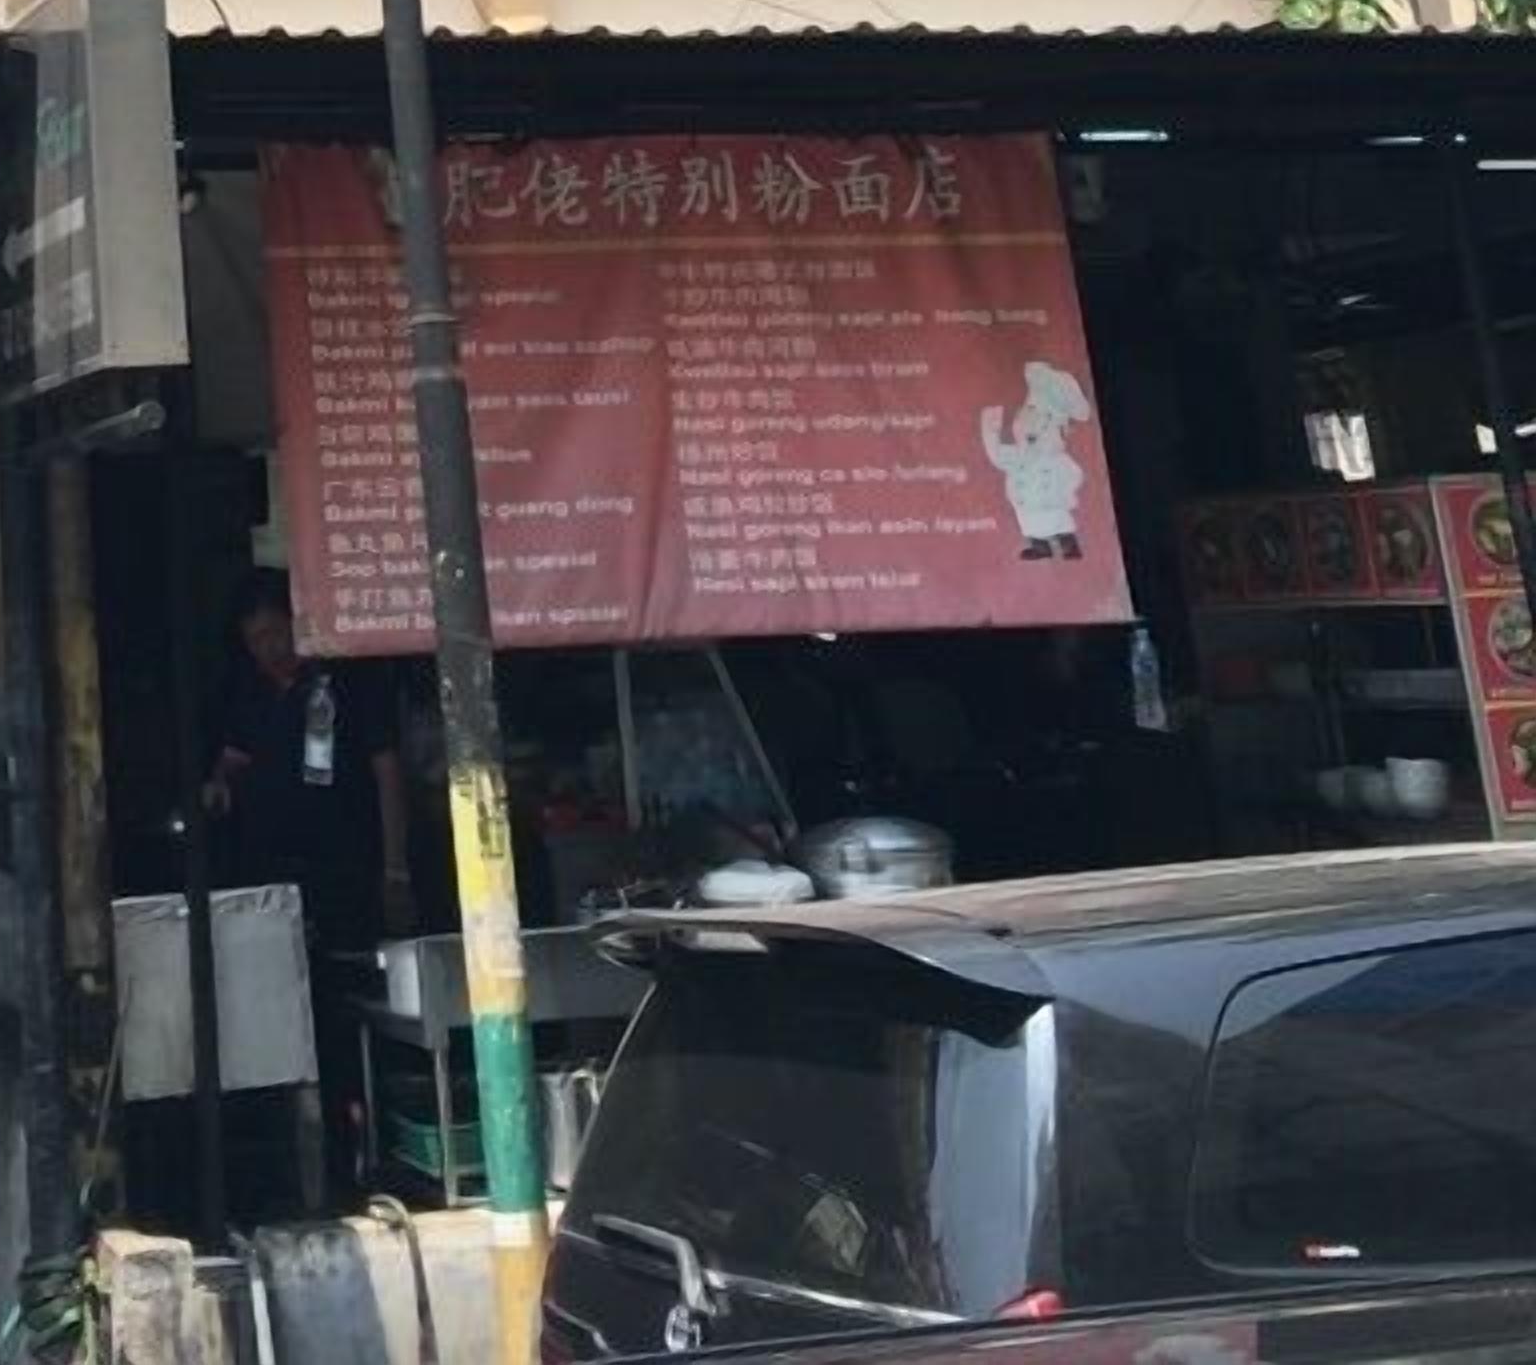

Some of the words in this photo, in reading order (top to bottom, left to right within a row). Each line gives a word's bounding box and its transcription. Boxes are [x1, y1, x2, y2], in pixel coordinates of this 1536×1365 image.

[372, 143, 963, 228] 肥佬特别粉面店
